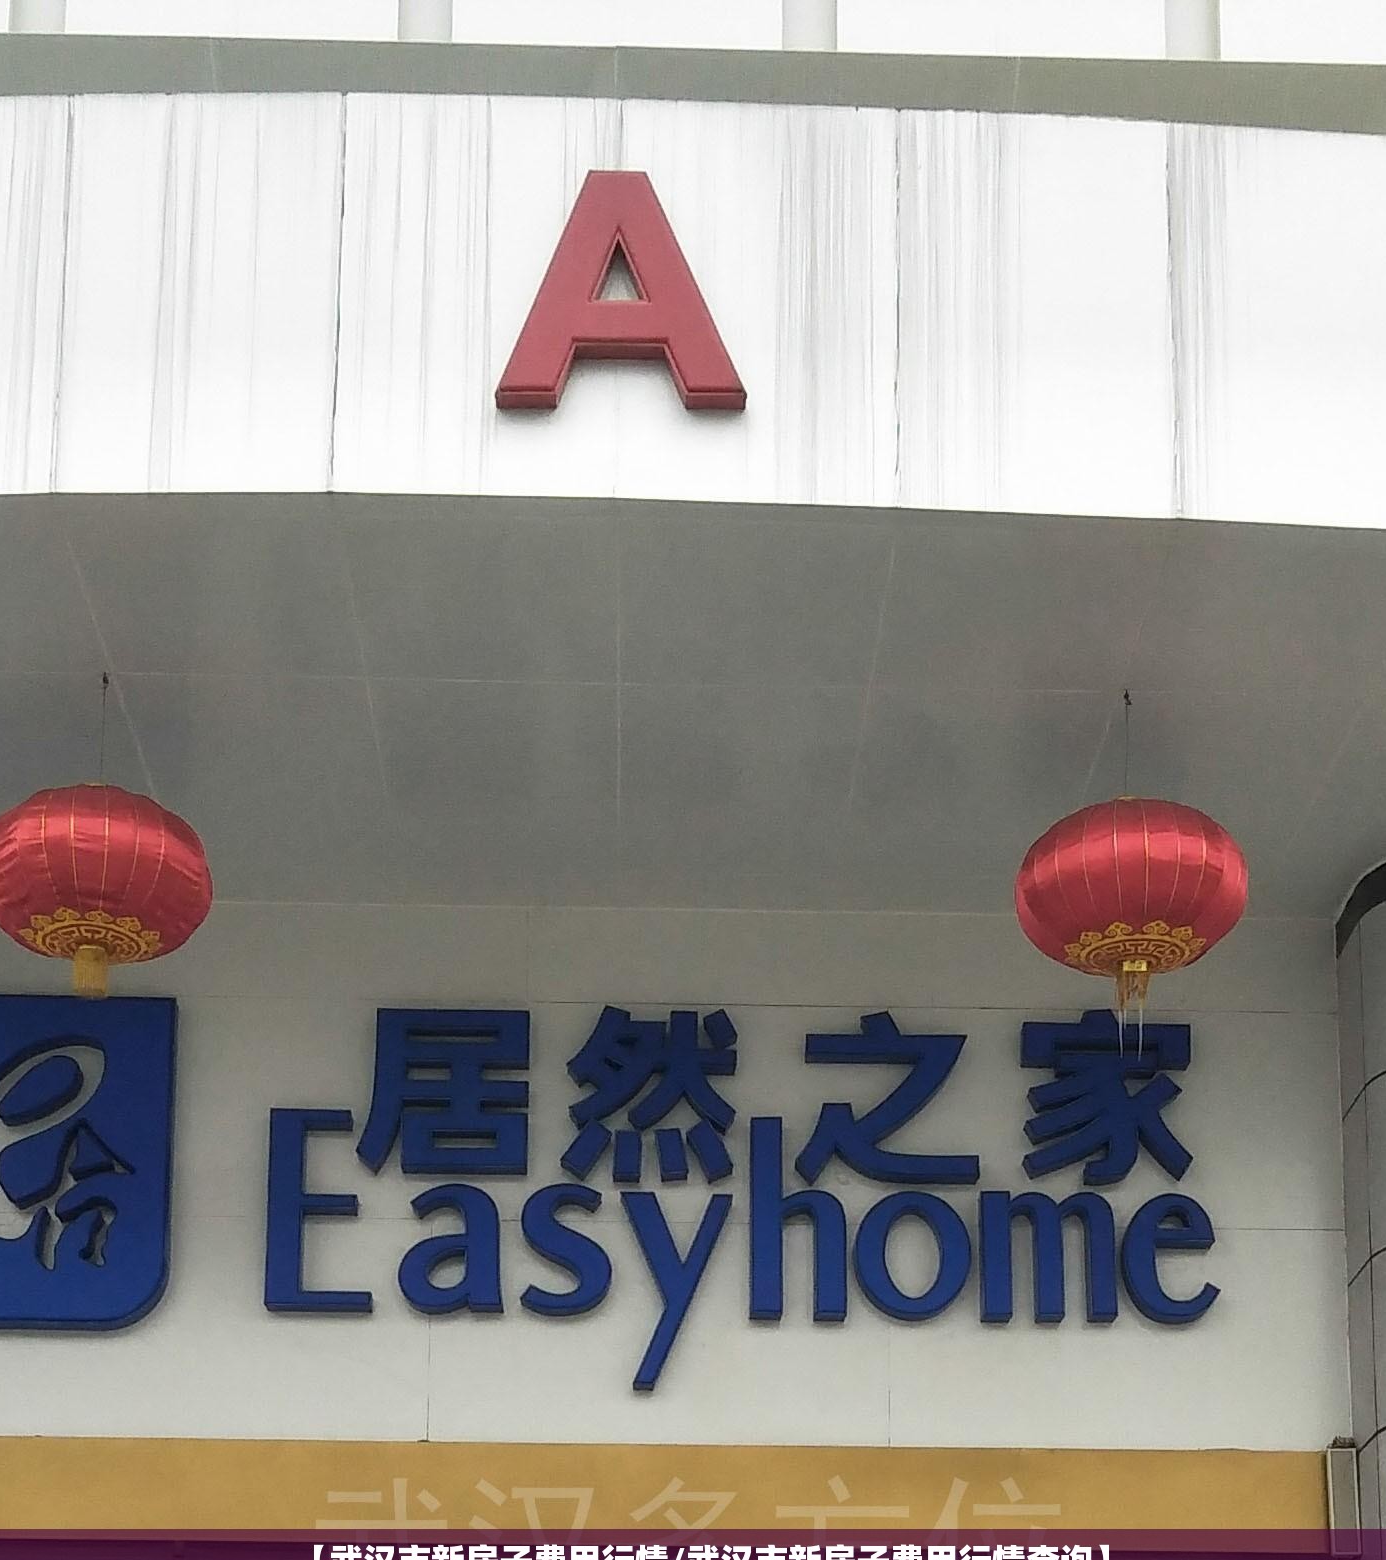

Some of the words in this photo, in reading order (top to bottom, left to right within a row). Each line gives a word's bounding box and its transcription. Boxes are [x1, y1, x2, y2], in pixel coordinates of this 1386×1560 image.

[495, 169, 748, 410] A
[355, 1005, 1194, 1188] 居然之家
[263, 1107, 1220, 1390] Easyhome
